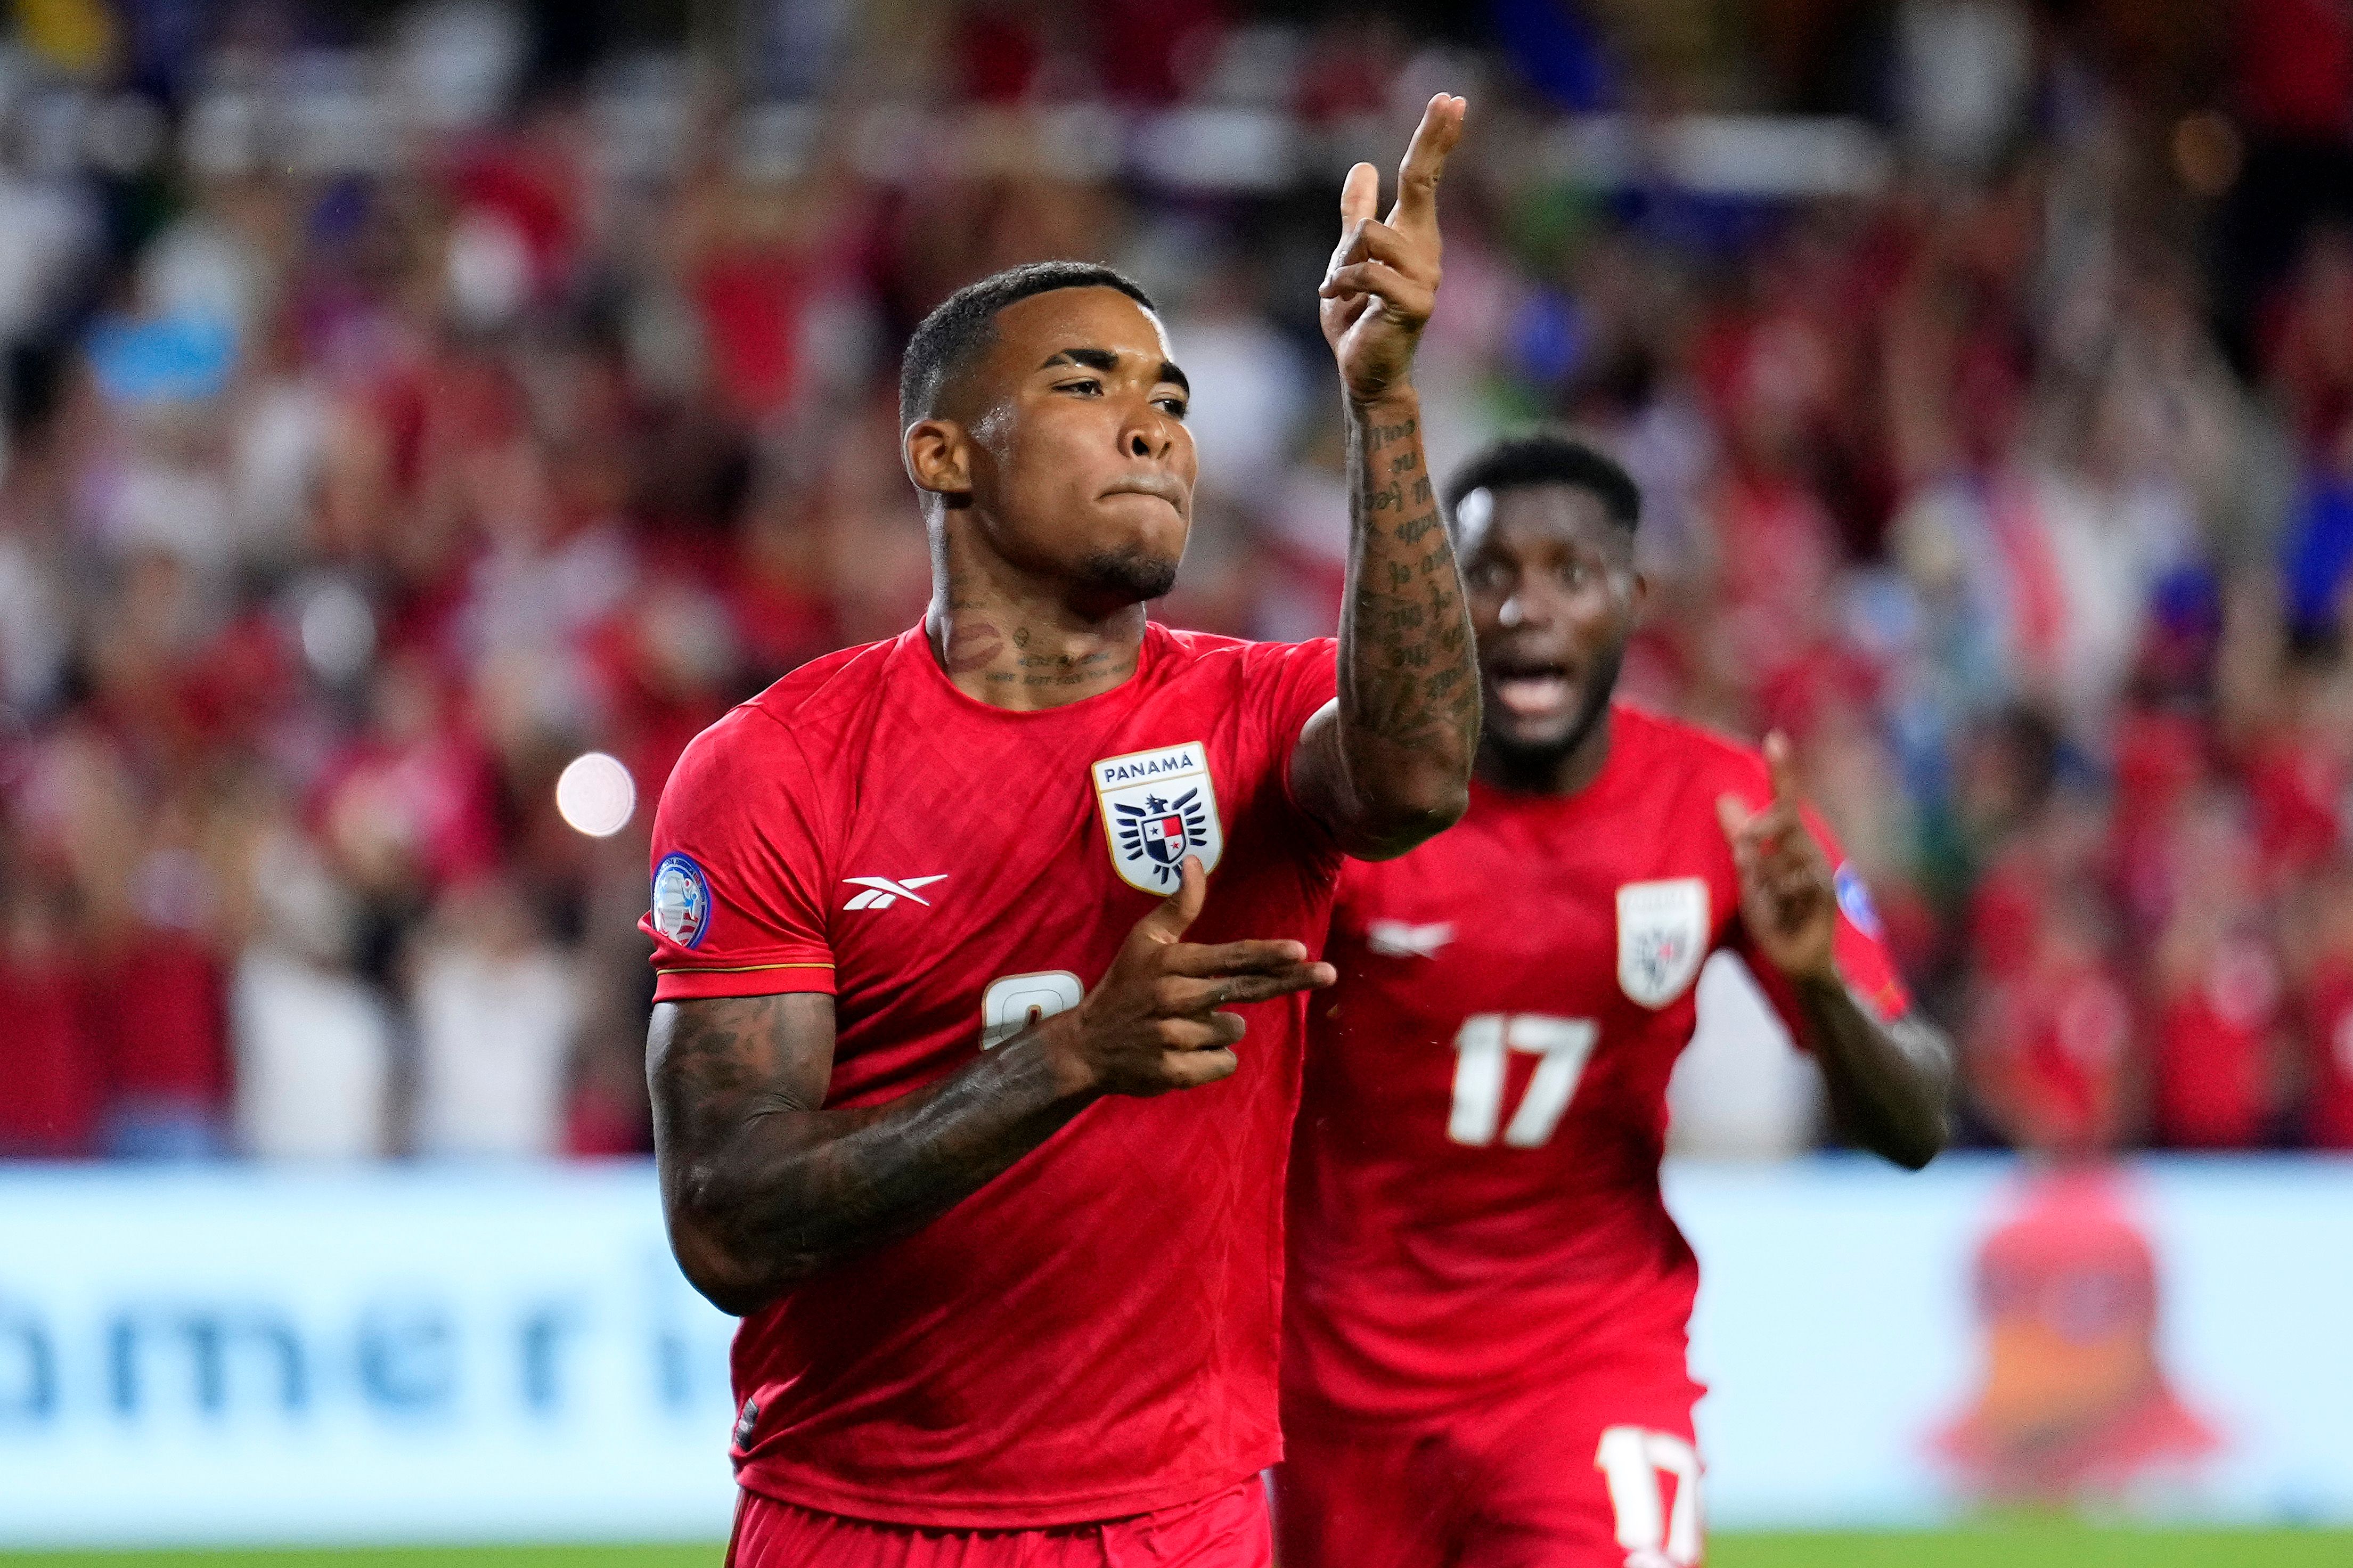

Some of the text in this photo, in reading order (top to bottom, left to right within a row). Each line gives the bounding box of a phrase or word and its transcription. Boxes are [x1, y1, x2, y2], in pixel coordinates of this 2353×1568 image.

[1104, 752, 1194, 783] PANAMÁ
[1445, 1012, 1600, 1147] 17
[1595, 1425, 1698, 1563] 17
